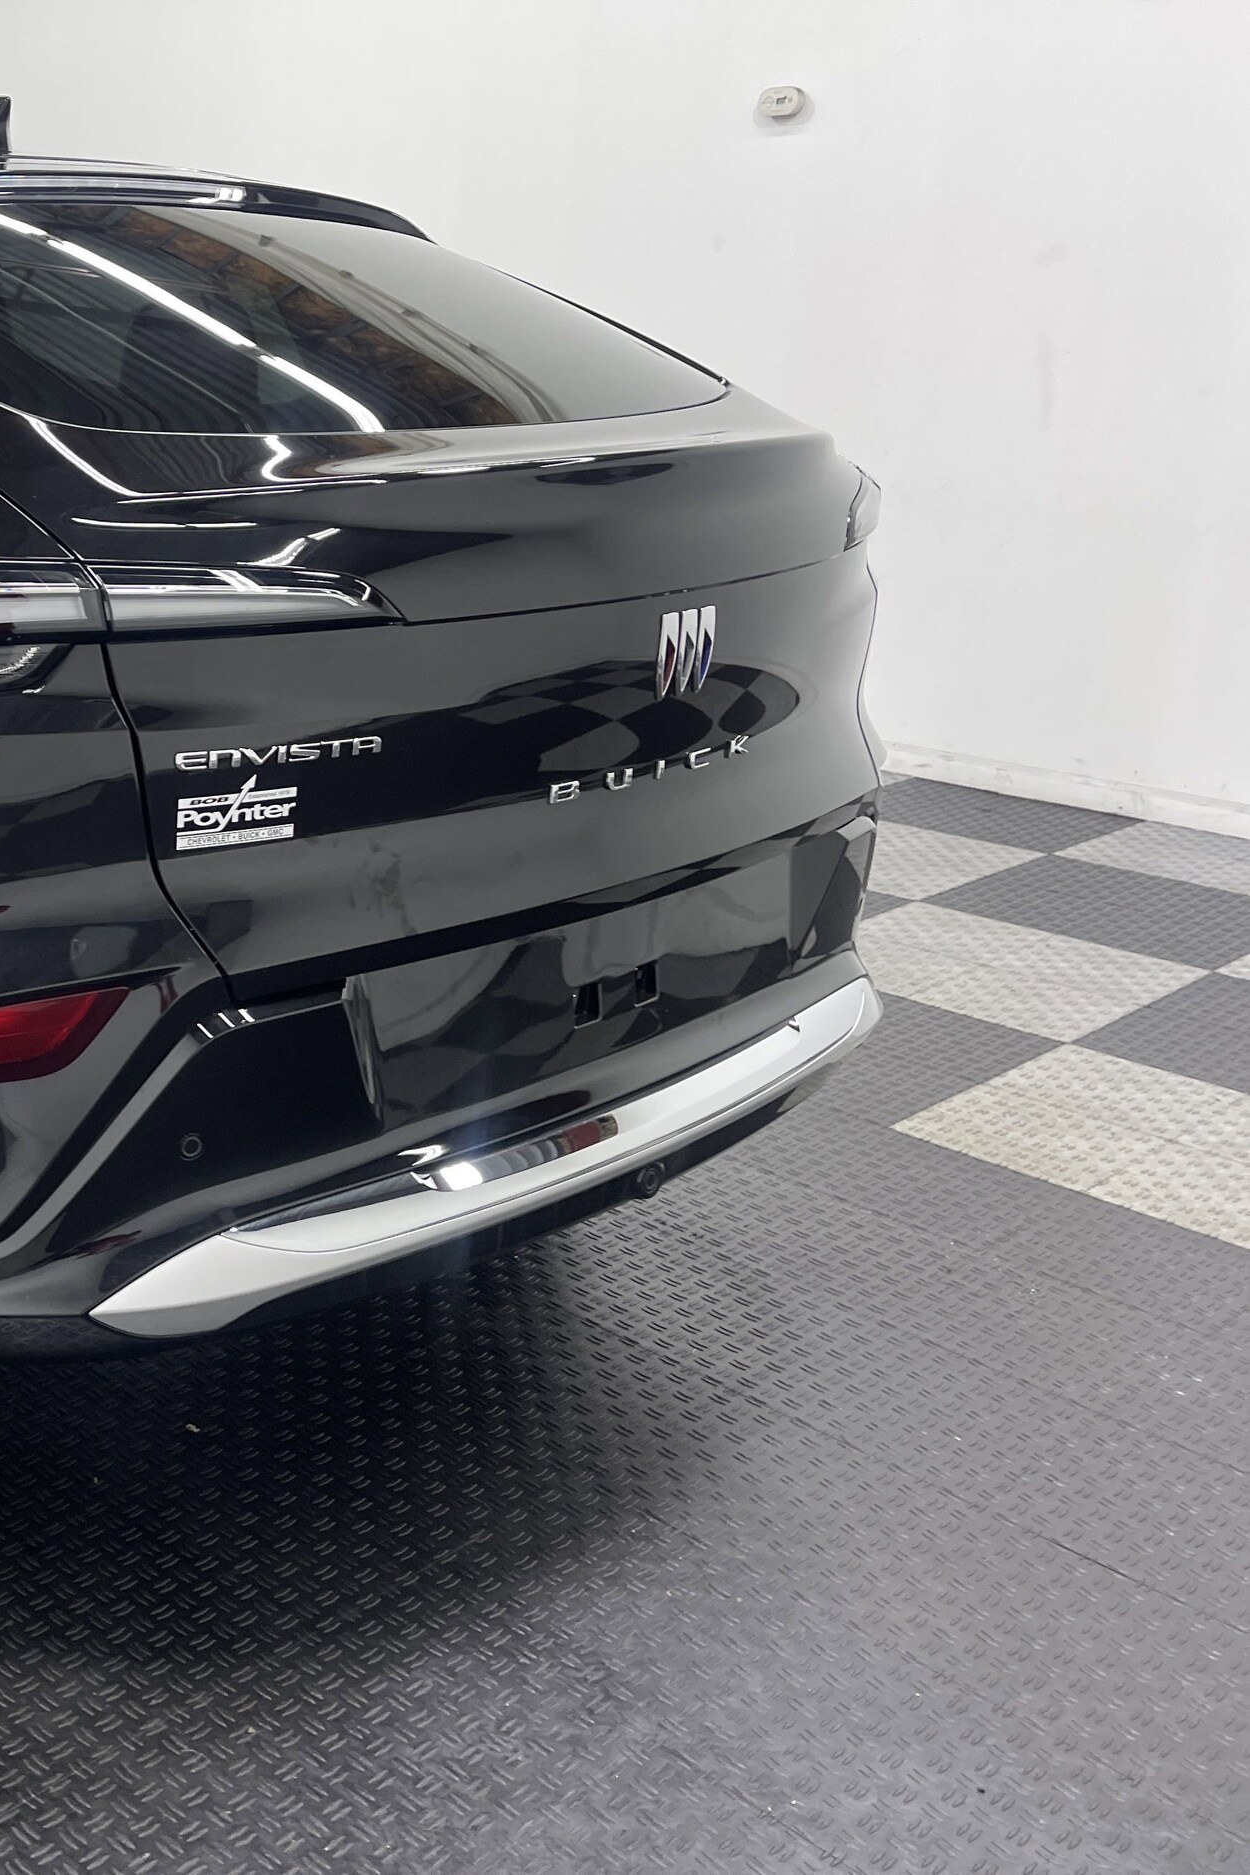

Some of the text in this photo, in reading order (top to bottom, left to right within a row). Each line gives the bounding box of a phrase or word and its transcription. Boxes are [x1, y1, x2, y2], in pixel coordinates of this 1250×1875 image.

[174, 736, 383, 771] ENVISTA
[549, 735, 749, 804] BUICK
[190, 797, 229, 806] BOB
[176, 802, 296, 830] Poynter
[187, 828, 284, 846] CHEVROLET BUICK GMC
